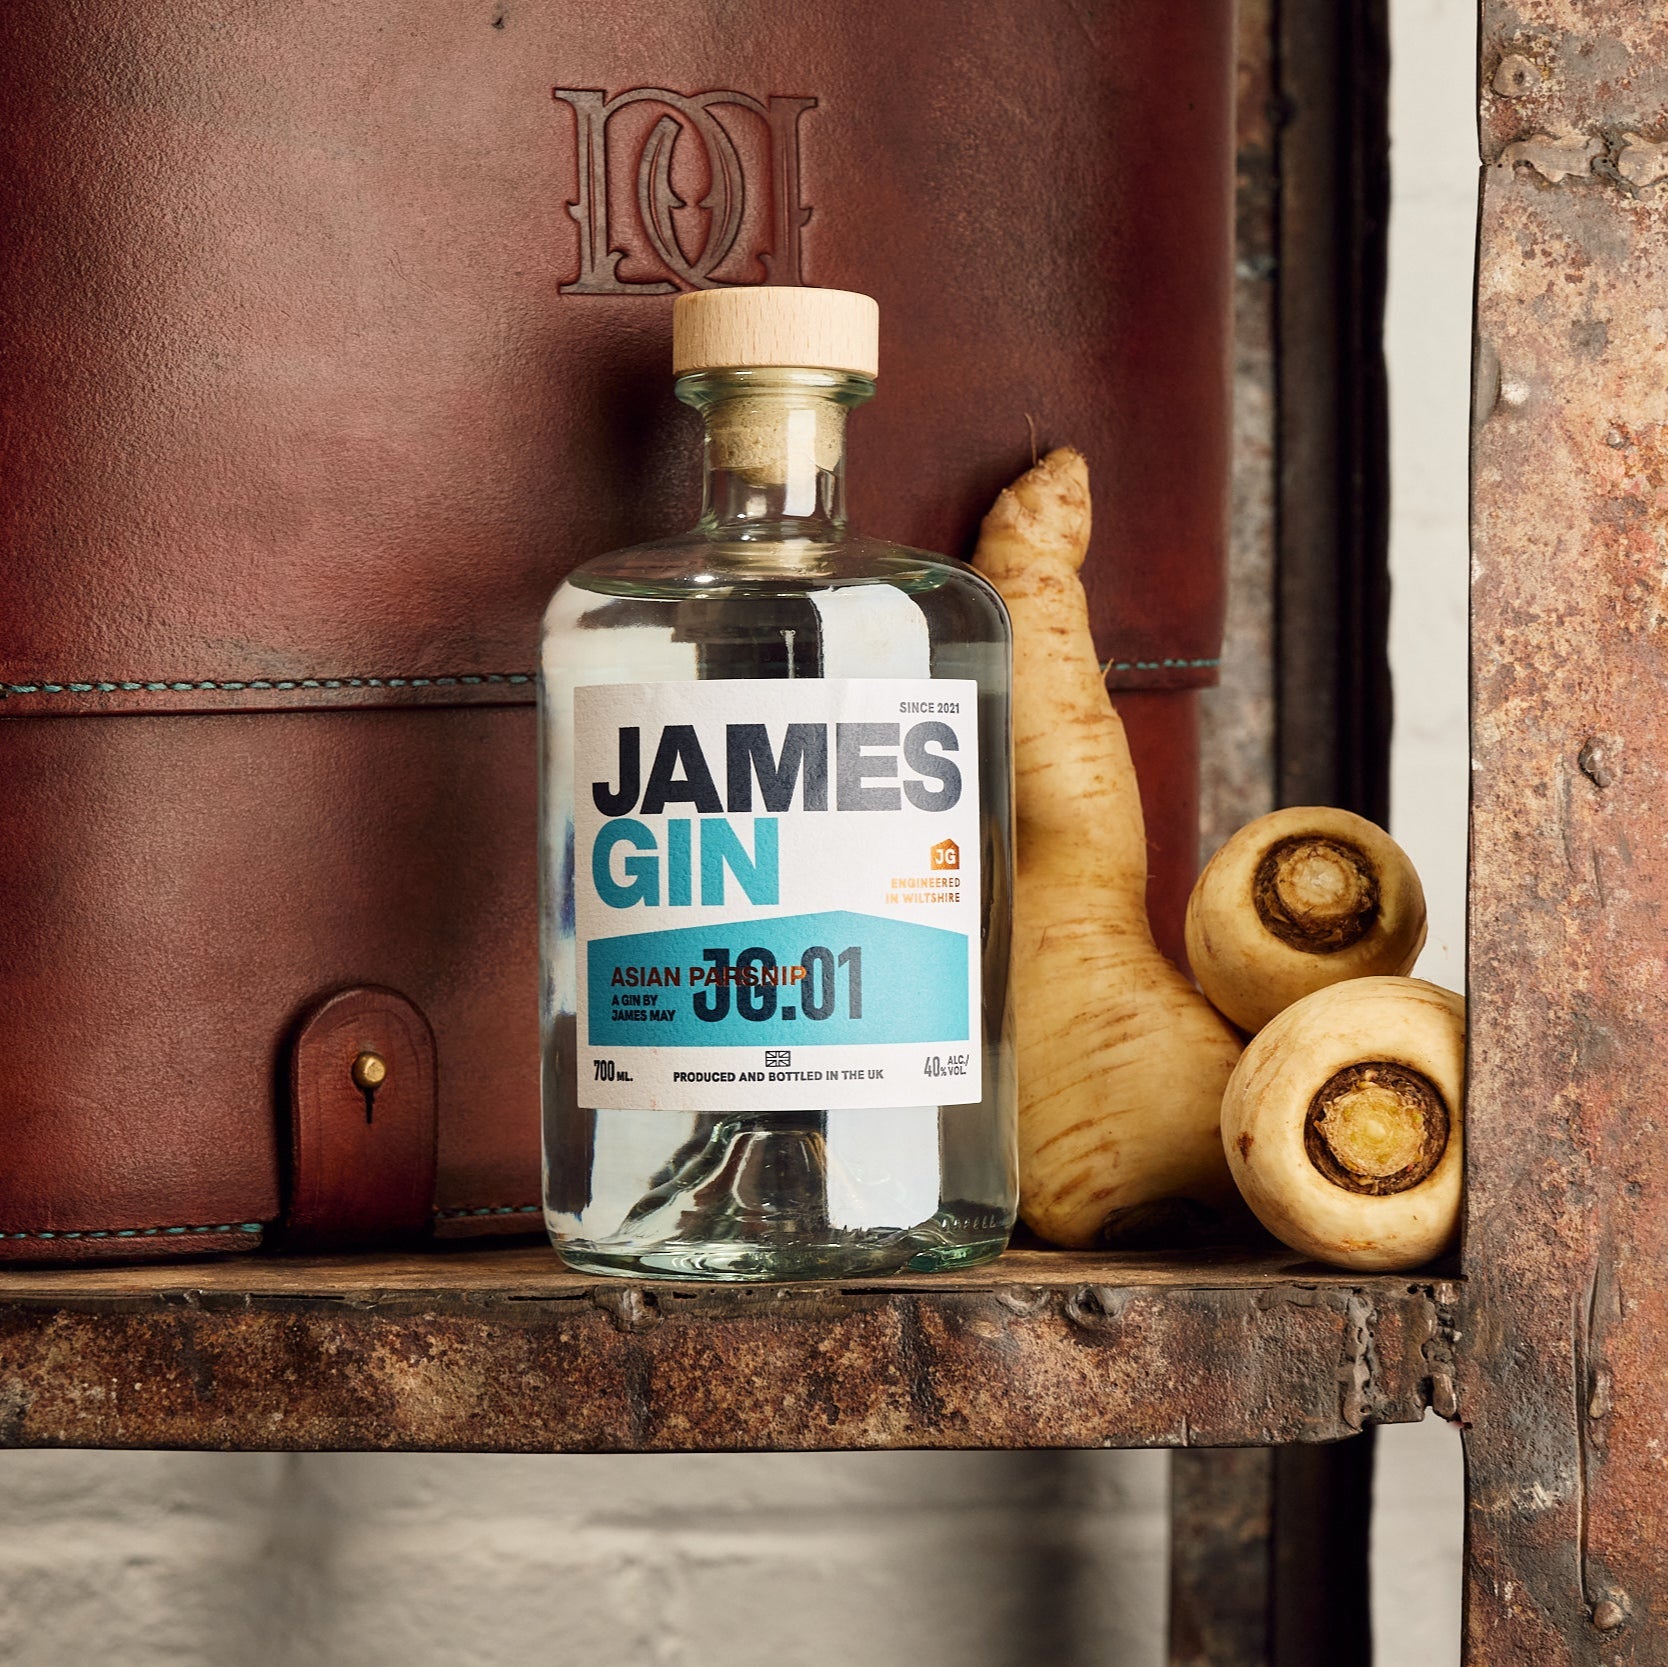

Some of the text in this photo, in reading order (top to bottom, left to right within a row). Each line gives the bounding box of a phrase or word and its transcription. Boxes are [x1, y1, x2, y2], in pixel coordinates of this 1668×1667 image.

[899, 701, 960, 714] SINCE 2021
[592, 720, 962, 817] JAMES
[592, 817, 779, 908] GIN
[935, 848, 957, 865] JG
[891, 877, 961, 889] ENGINEERED
[885, 892, 961, 904] IN WILTSHIRE
[611, 965, 807, 987] ASIAN PARSNIP
[692, 946, 862, 1023] JG.01
[611, 994, 659, 1007] A GIN BY
[611, 1009, 676, 1022] JAMES MAY
[593, 1059, 615, 1081] 700
[673, 1069, 885, 1082] PRODUCED AND BOTTLED IN THE UK
